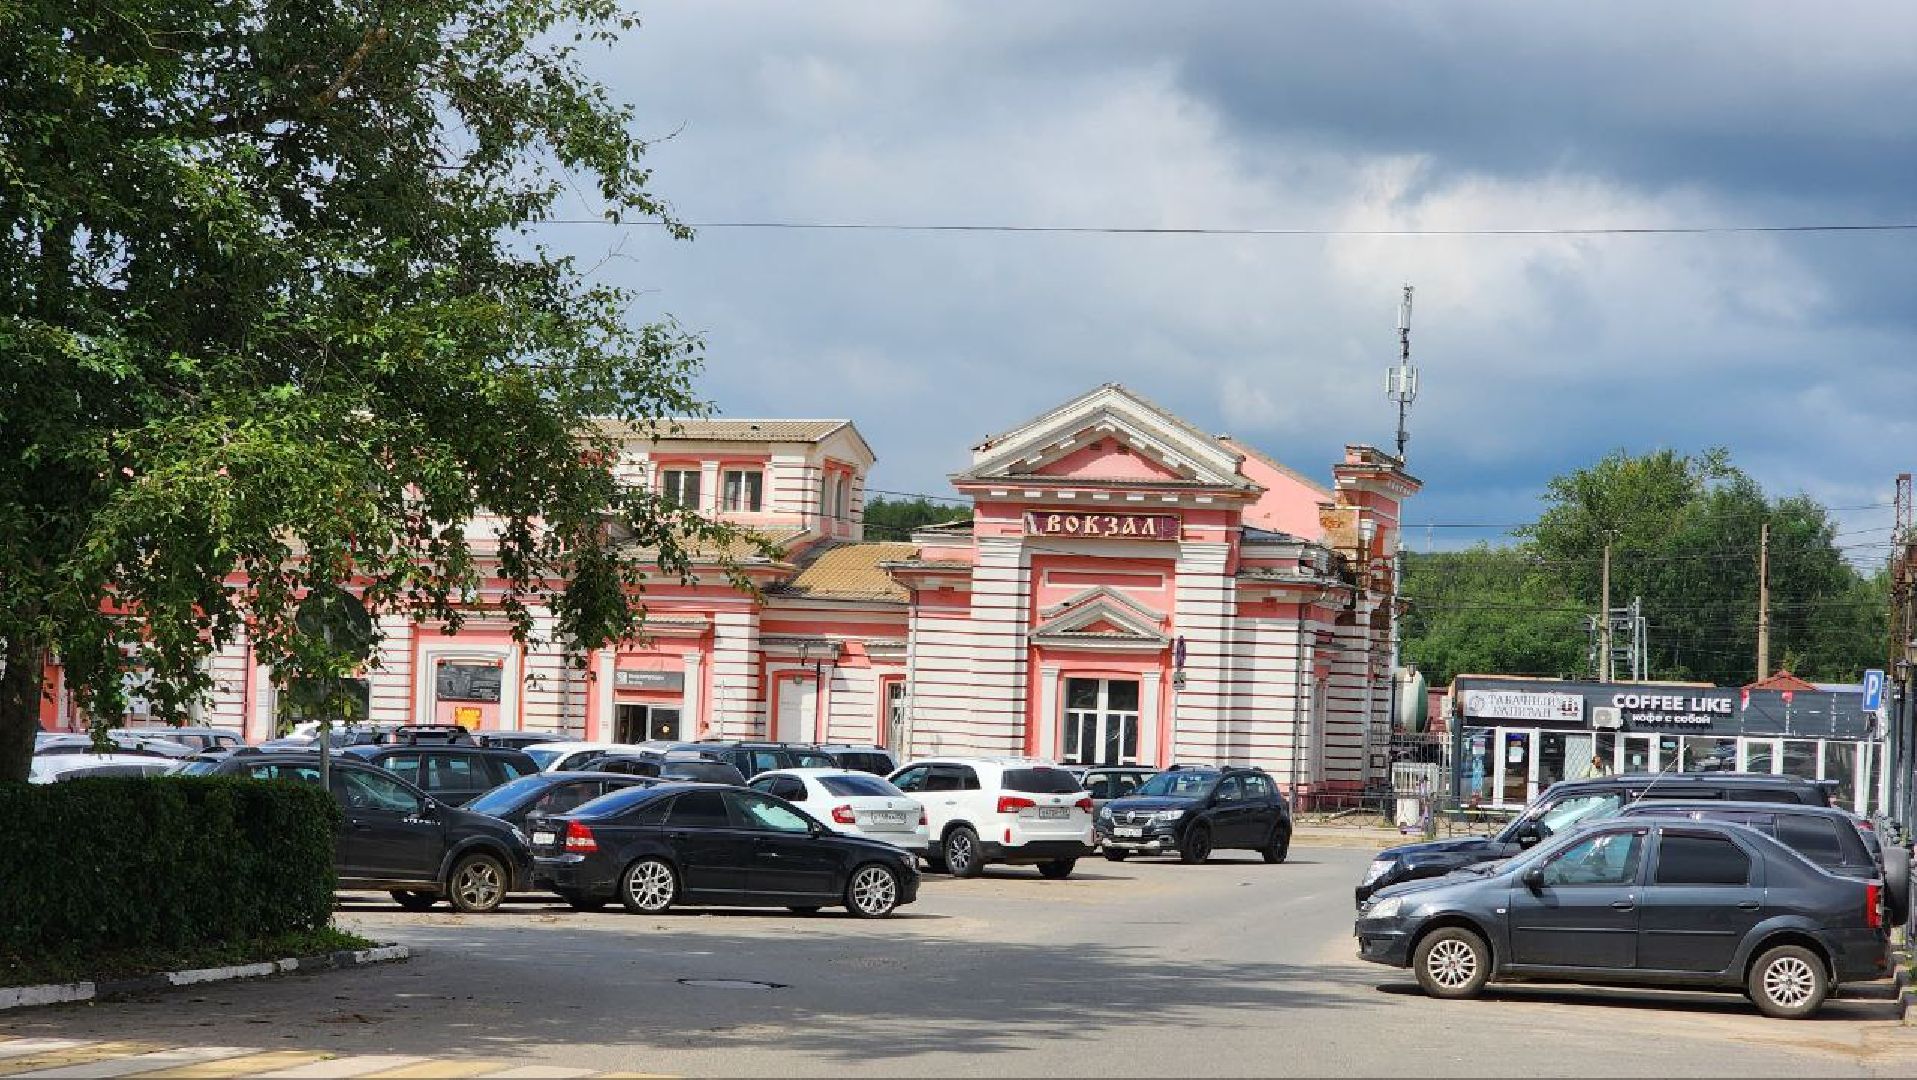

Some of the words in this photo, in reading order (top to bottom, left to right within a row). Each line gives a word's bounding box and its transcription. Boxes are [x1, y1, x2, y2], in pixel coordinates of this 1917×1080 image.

[1045, 514, 1157, 537] ВОКЗАЛ
[1612, 694, 1684, 711] COFFEE
[1691, 697, 1732, 714] LIKE
[1632, 713, 1663, 724] кофе
[1664, 714, 1672, 722] с
[1674, 714, 1711, 724] собой
